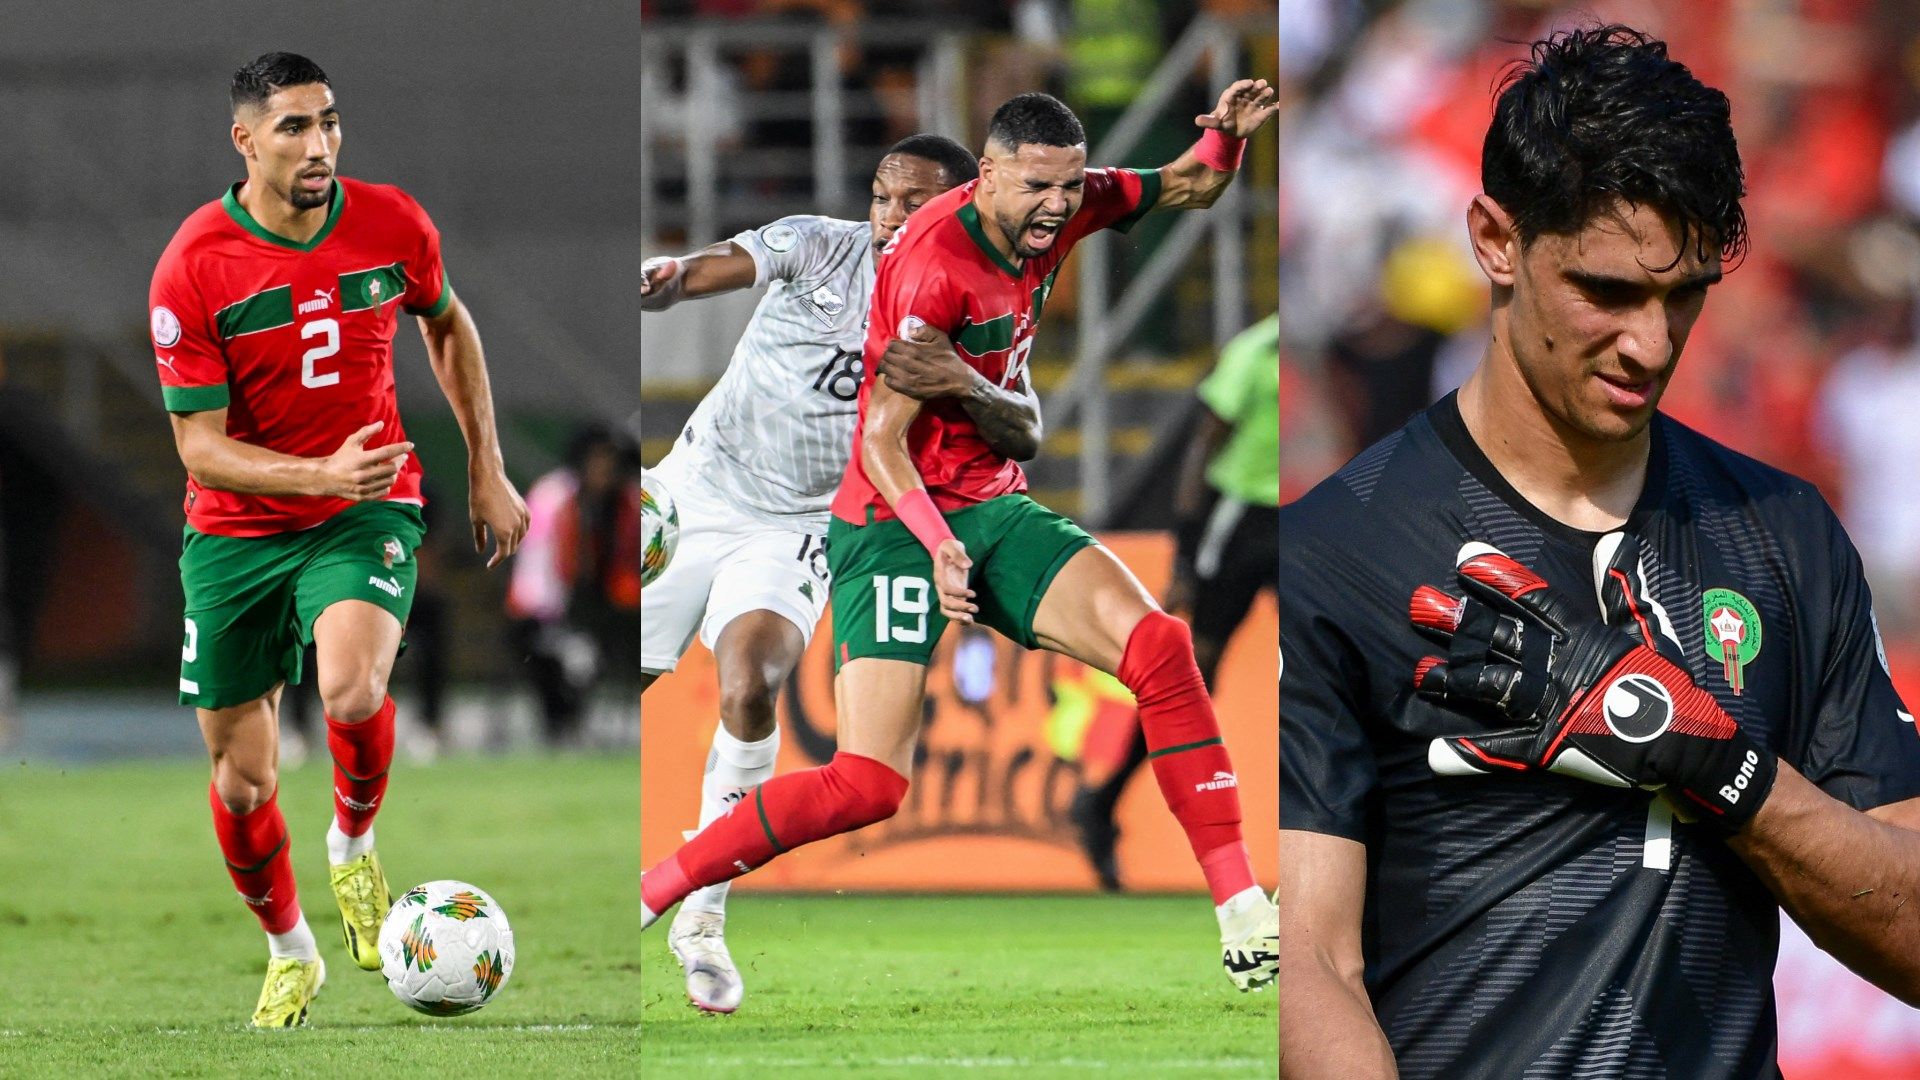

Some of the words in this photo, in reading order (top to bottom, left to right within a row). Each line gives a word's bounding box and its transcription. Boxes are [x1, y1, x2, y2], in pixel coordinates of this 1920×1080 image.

[298, 297, 329, 315] PUMA
[301, 318, 340, 389] 2
[812, 345, 865, 402] 18
[873, 575, 930, 643] 19
[1718, 750, 1759, 805] Bono
